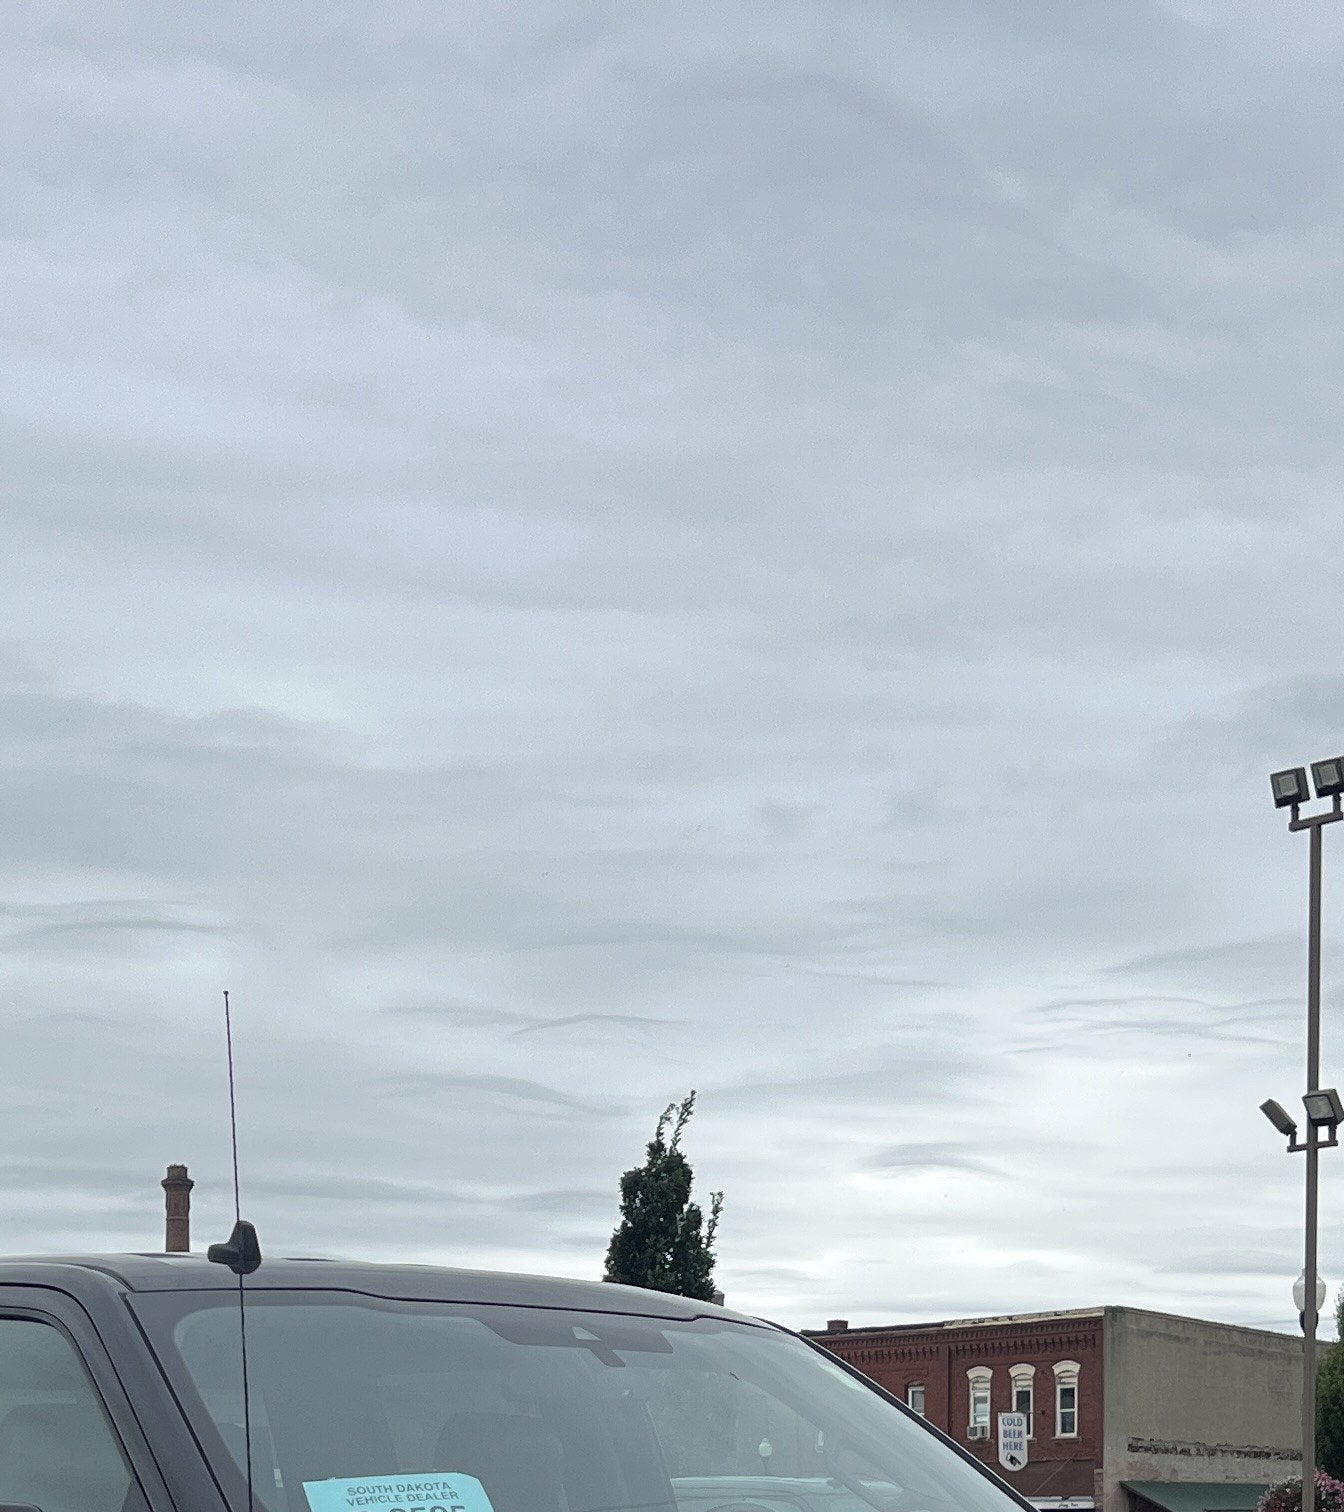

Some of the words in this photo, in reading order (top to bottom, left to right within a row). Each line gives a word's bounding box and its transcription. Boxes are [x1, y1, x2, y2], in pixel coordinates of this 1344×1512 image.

[1003, 1418, 1023, 1427] COLD
[1003, 1442, 1024, 1451] HERE
[348, 1486, 394, 1497] SOUTH
[397, 1482, 452, 1493] DAKOTA
[347, 1494, 404, 1508] VEHICLE
[406, 1491, 459, 1502] DEALER
